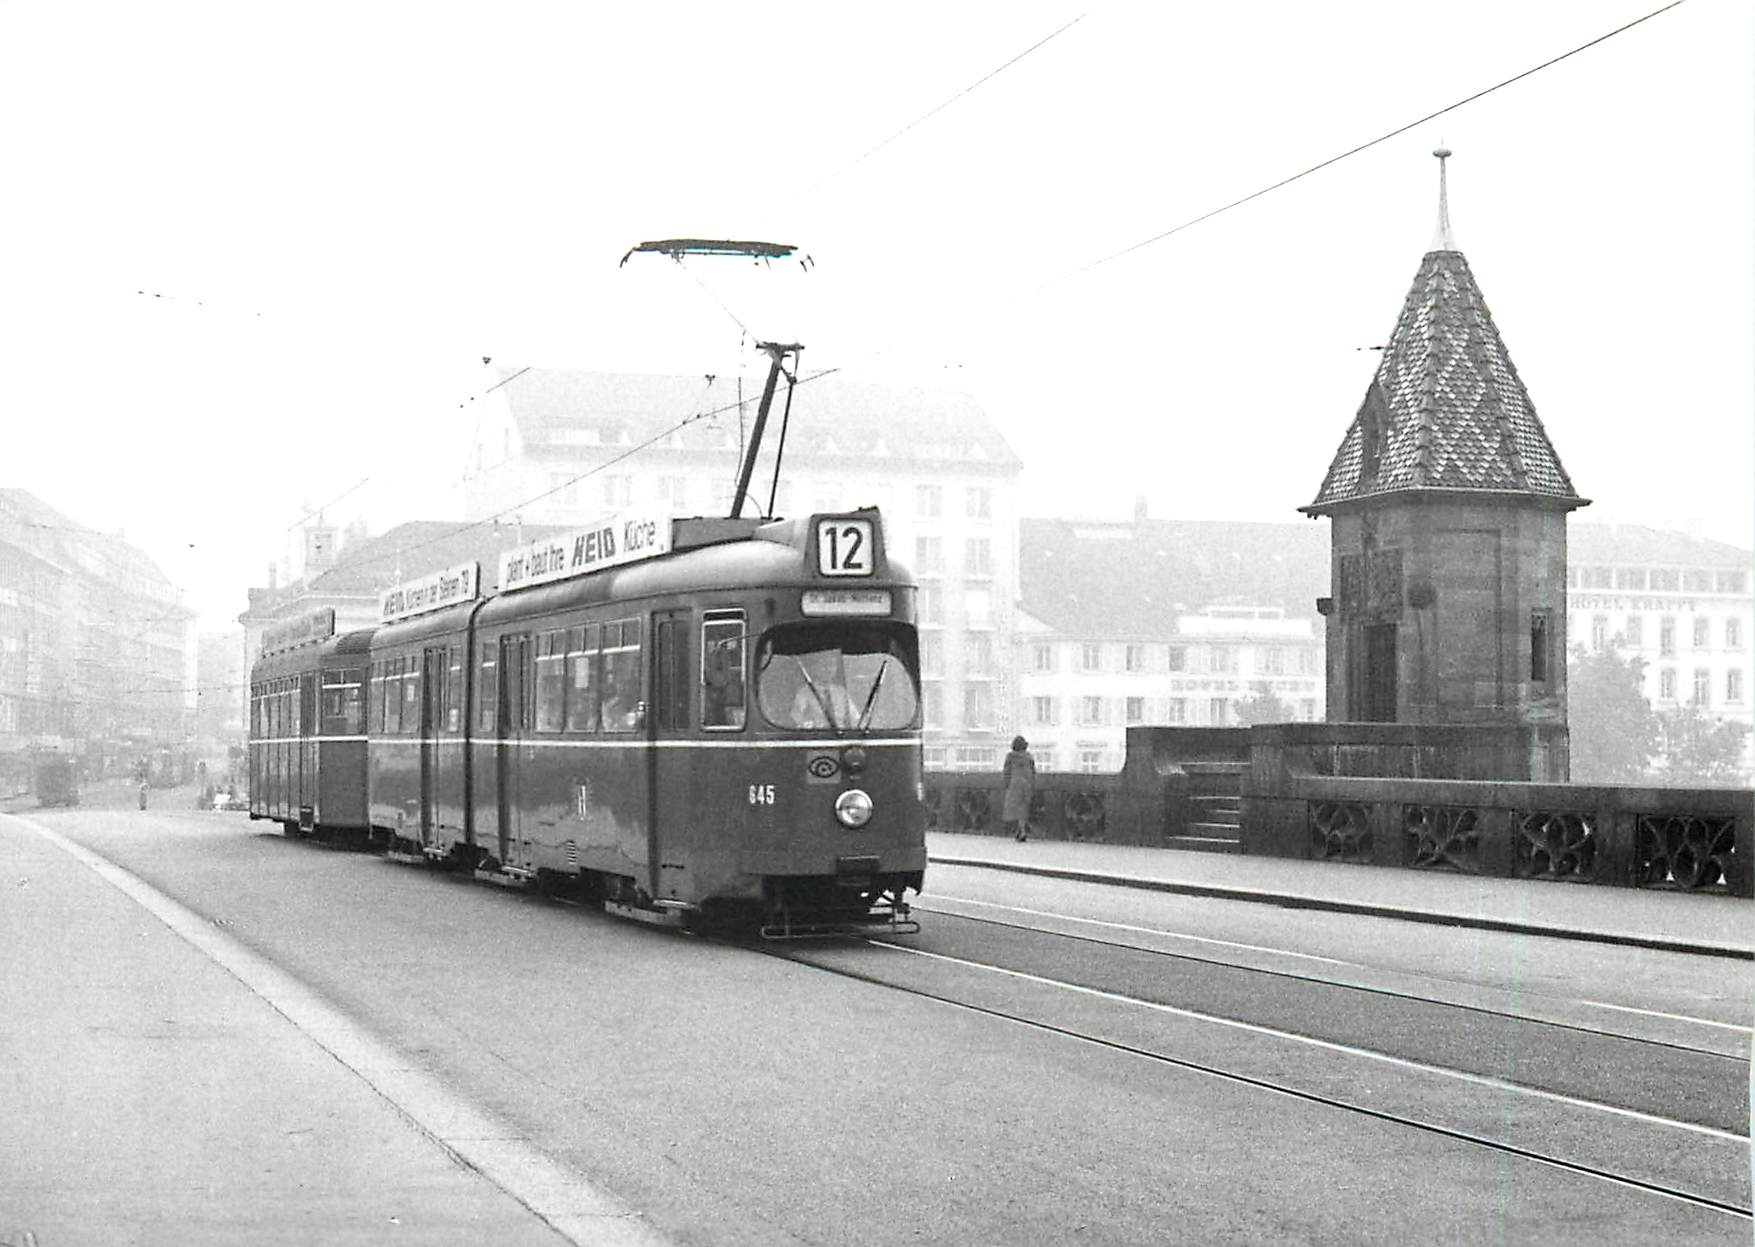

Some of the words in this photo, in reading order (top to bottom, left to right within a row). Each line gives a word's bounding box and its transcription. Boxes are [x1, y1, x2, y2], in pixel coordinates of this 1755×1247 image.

[571, 527, 616, 567] HEID
[623, 518, 656, 552] Küche
[824, 526, 863, 570] 12
[1569, 597, 1623, 611] HOTEL
[749, 784, 775, 805] 645
